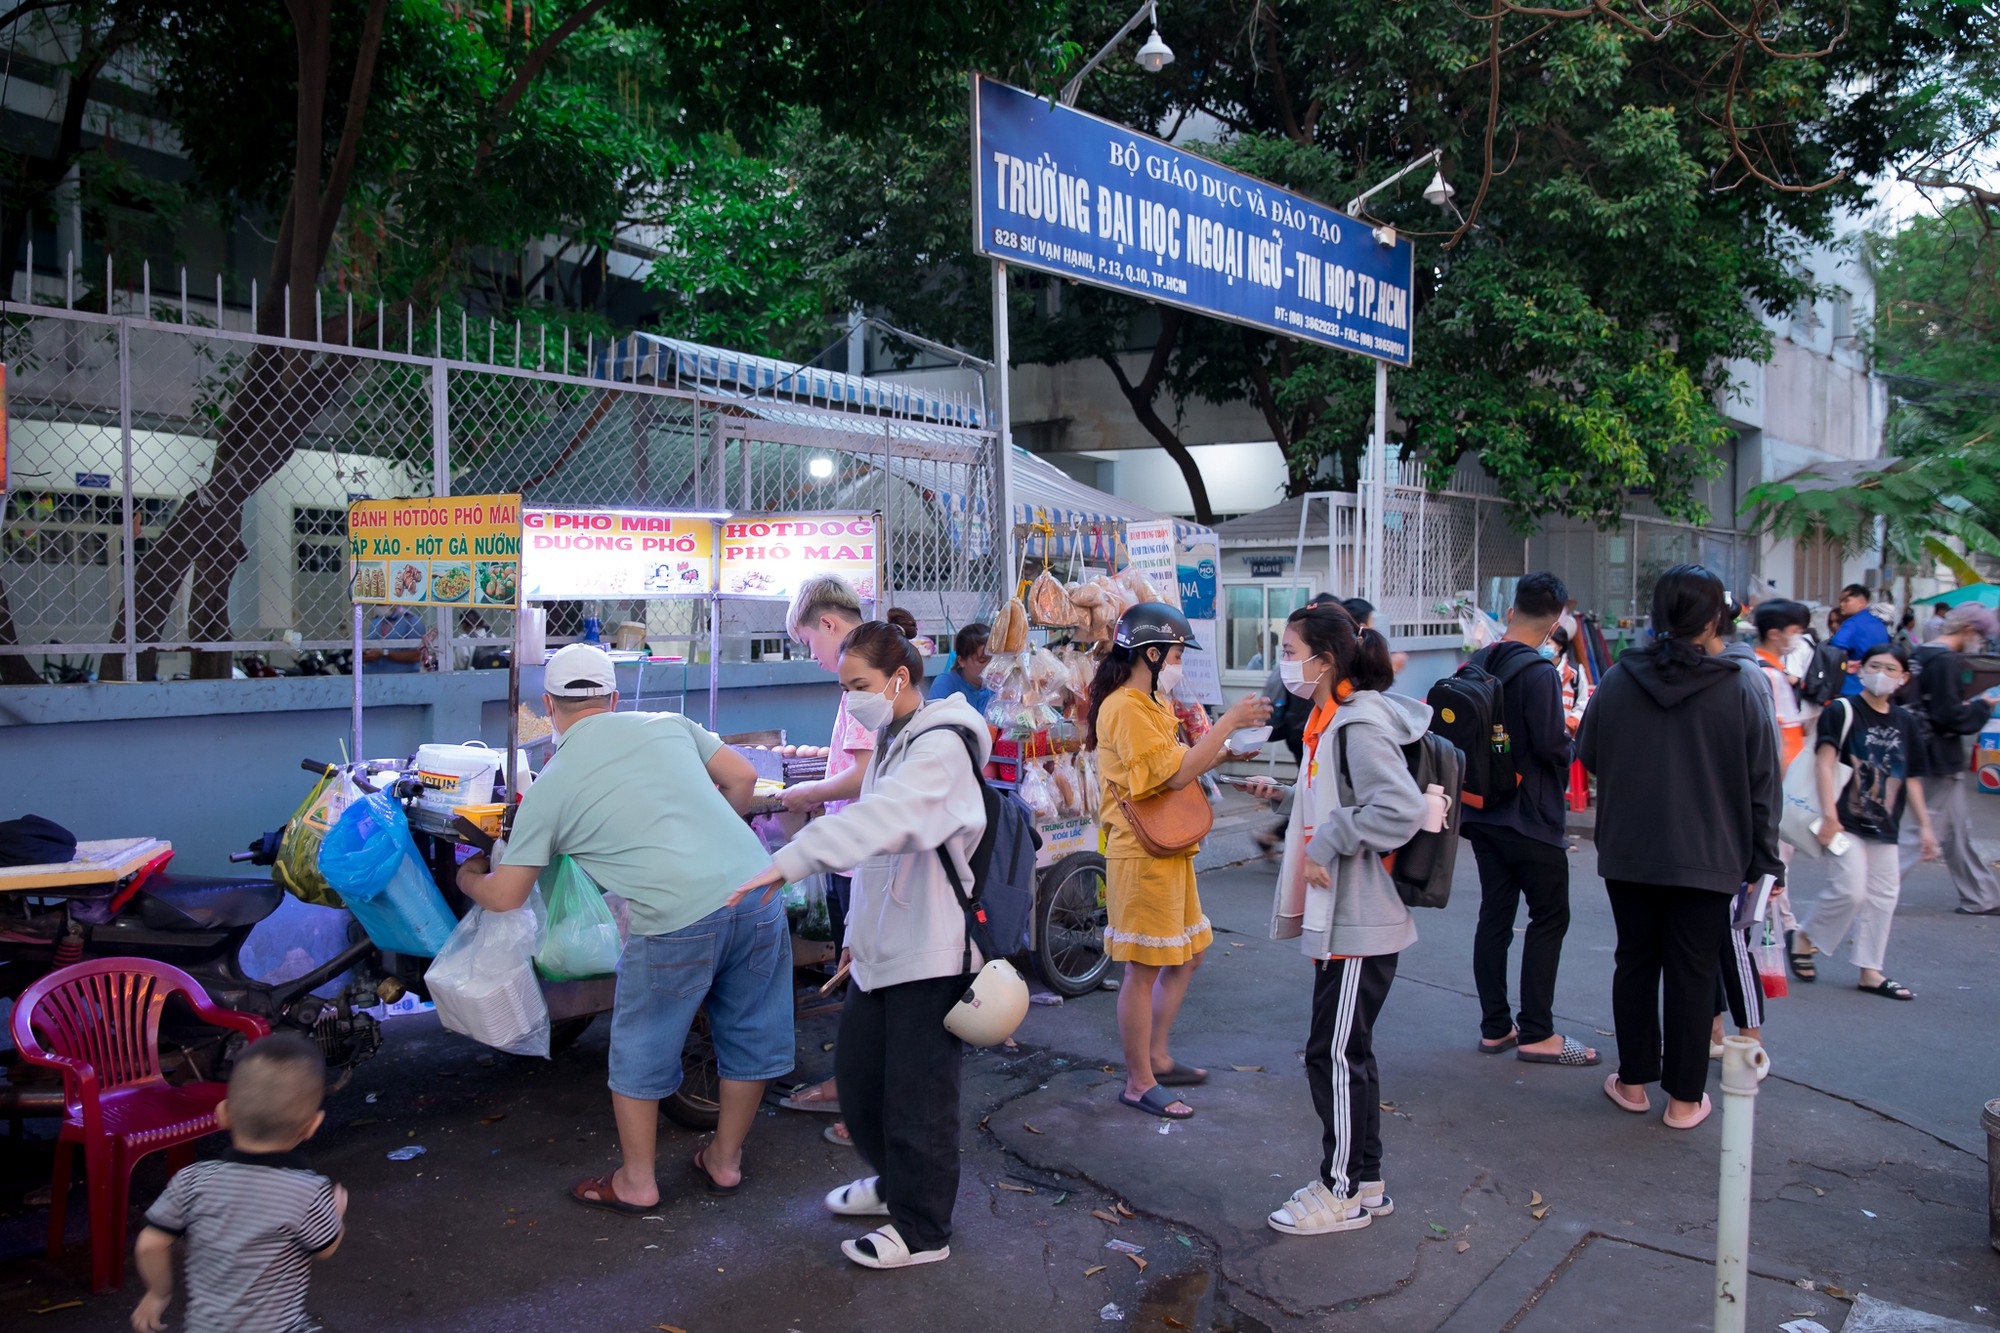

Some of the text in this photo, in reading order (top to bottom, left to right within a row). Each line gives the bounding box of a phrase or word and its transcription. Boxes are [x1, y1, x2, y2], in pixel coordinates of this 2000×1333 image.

[1109, 140, 1341, 244] BỘ GIÁO DỤC VÀ ĐÀO TẠO
[993, 151, 1090, 234] TRƯỜNG
[1097, 185, 1134, 255] ĐẠI
[1139, 198, 1180, 266] HỌC
[1186, 214, 1243, 286] NGOẠI
[1248, 229, 1283, 290] NGỮ
[1296, 251, 1321, 303] TIN
[1325, 262, 1355, 320] HỌC
[1358, 273, 1407, 330] TP.HCM
[994, 228, 1187, 295] 828 SƯ VẠN HẠNH, P.13, Q.10, TP.HCM
[1274, 306, 1287, 321] ĐT:
[1289, 310, 1303, 328] (08)
[1344, 327, 1359, 343] FAX:
[352, 503, 515, 527] BÁNH HOTDOG PHÔ MAI
[621, 517, 671, 532] MAI
[726, 521, 873, 538] HOTDOG
[373, 534, 400, 555] XÀO
[416, 534, 443, 560] HỘT
[449, 533, 468, 555] GÀ
[534, 533, 696, 552] ĐƯỜNG PHỐ
[726, 542, 873, 559] PHÔ MAI
